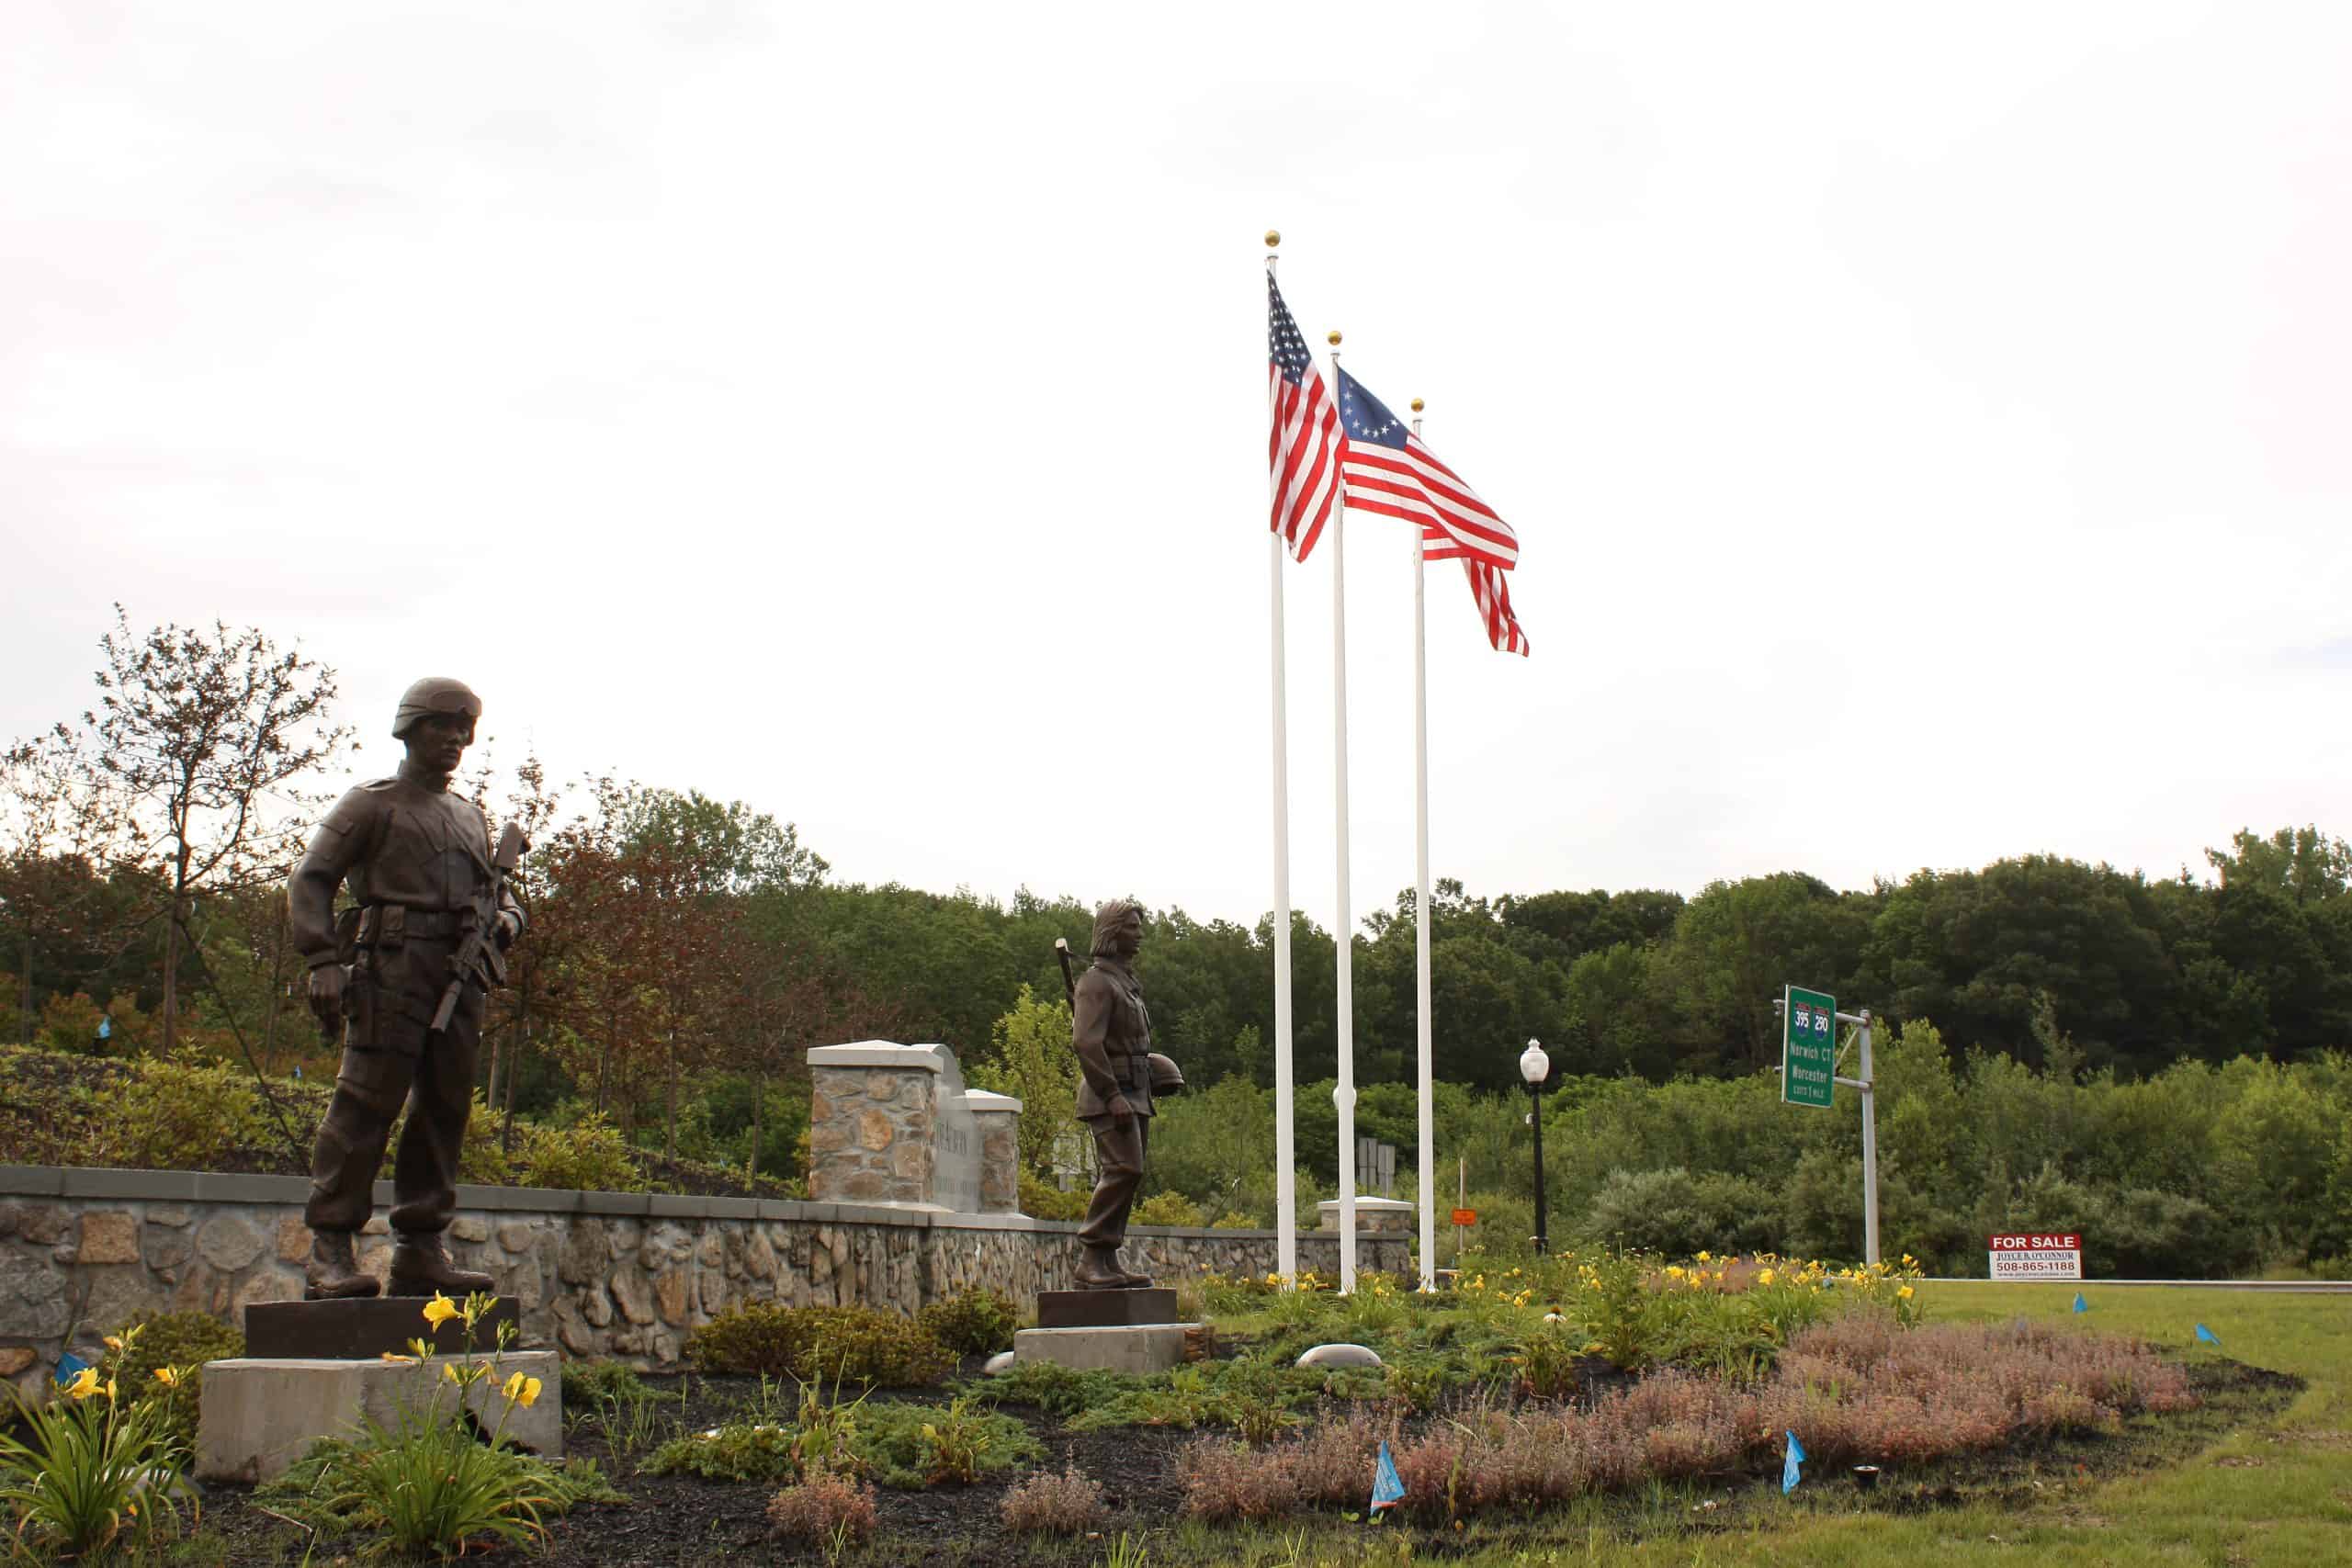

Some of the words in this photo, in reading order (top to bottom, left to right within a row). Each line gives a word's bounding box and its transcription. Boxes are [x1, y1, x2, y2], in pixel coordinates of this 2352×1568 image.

[1795, 1010, 1809, 1028] 395
[1815, 1014, 1828, 1032] 290
[1791, 1041, 1818, 1061] Norwich
[1821, 1047, 1831, 1063] CT
[1792, 1066, 1827, 1084] Worcester
[1993, 1237, 2028, 1248] FOR
[2031, 1236, 2075, 1248] SALE
[1996, 1262, 2075, 1271] 508-865-1188
